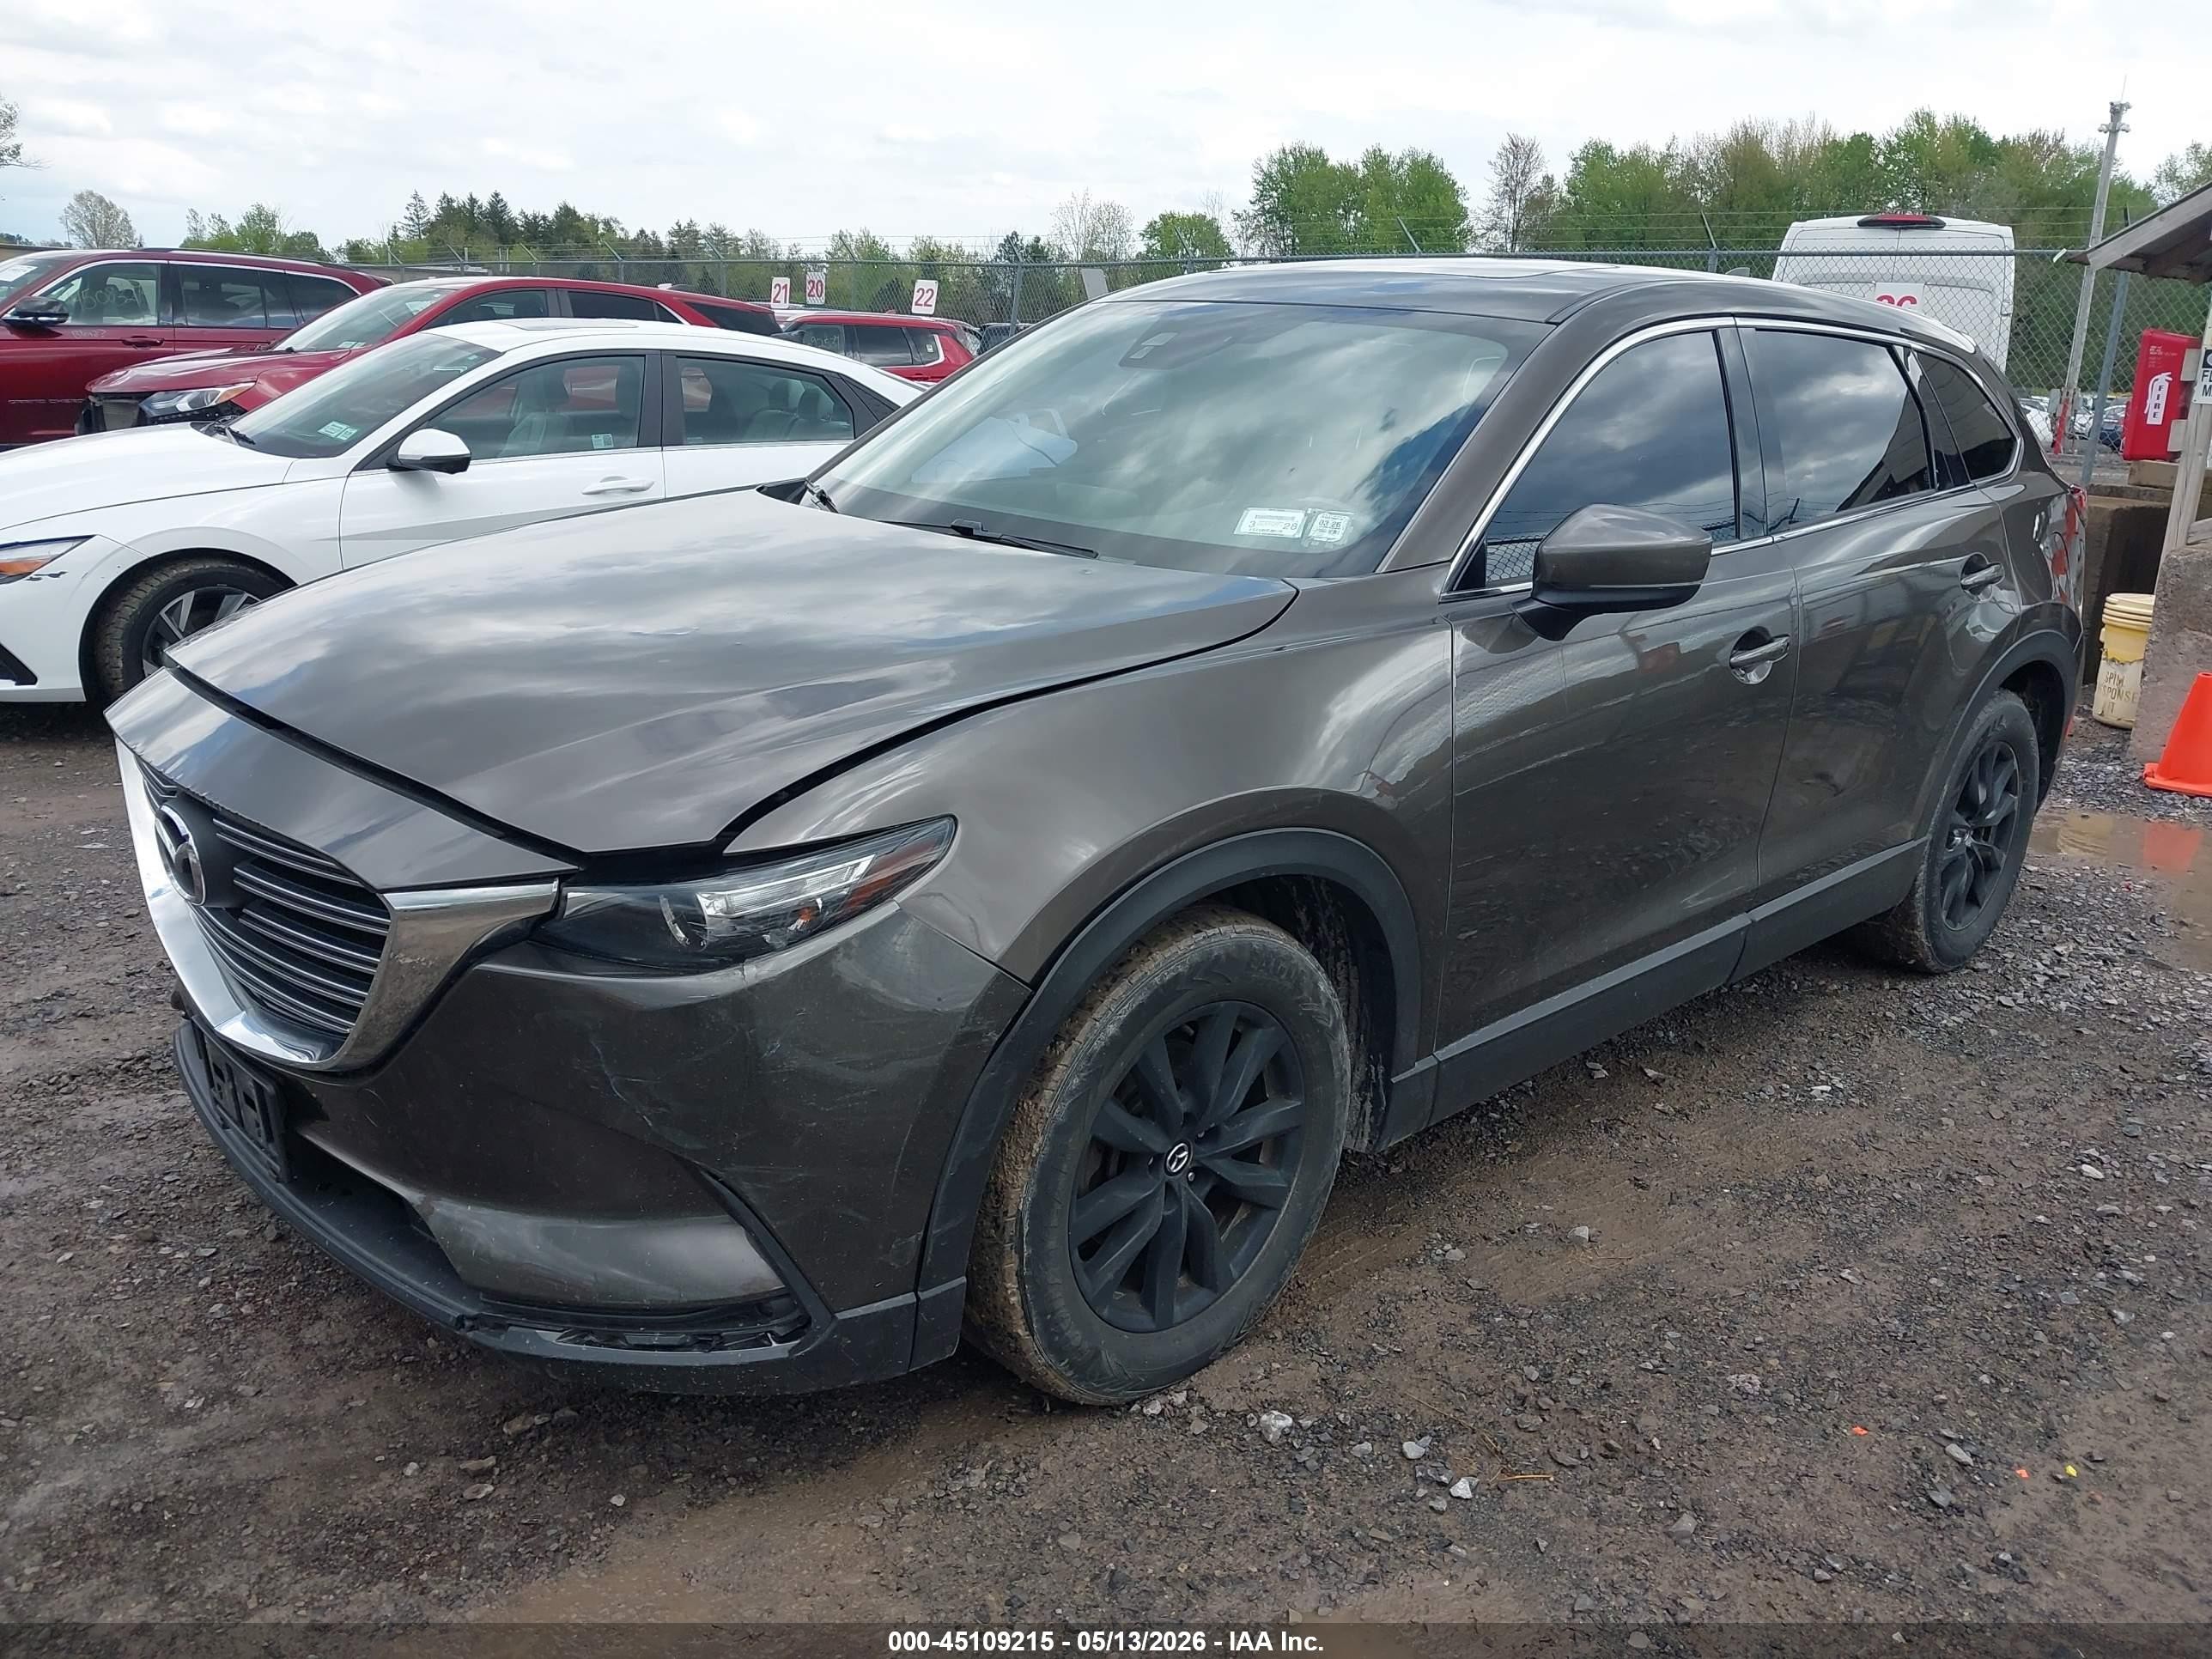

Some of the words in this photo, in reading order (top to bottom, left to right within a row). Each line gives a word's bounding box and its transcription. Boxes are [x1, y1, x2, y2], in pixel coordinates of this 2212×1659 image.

[772, 283, 788, 304] 21
[807, 279, 823, 298] 20
[914, 287, 935, 307] 22
[2152, 385, 2165, 419] FIRE
